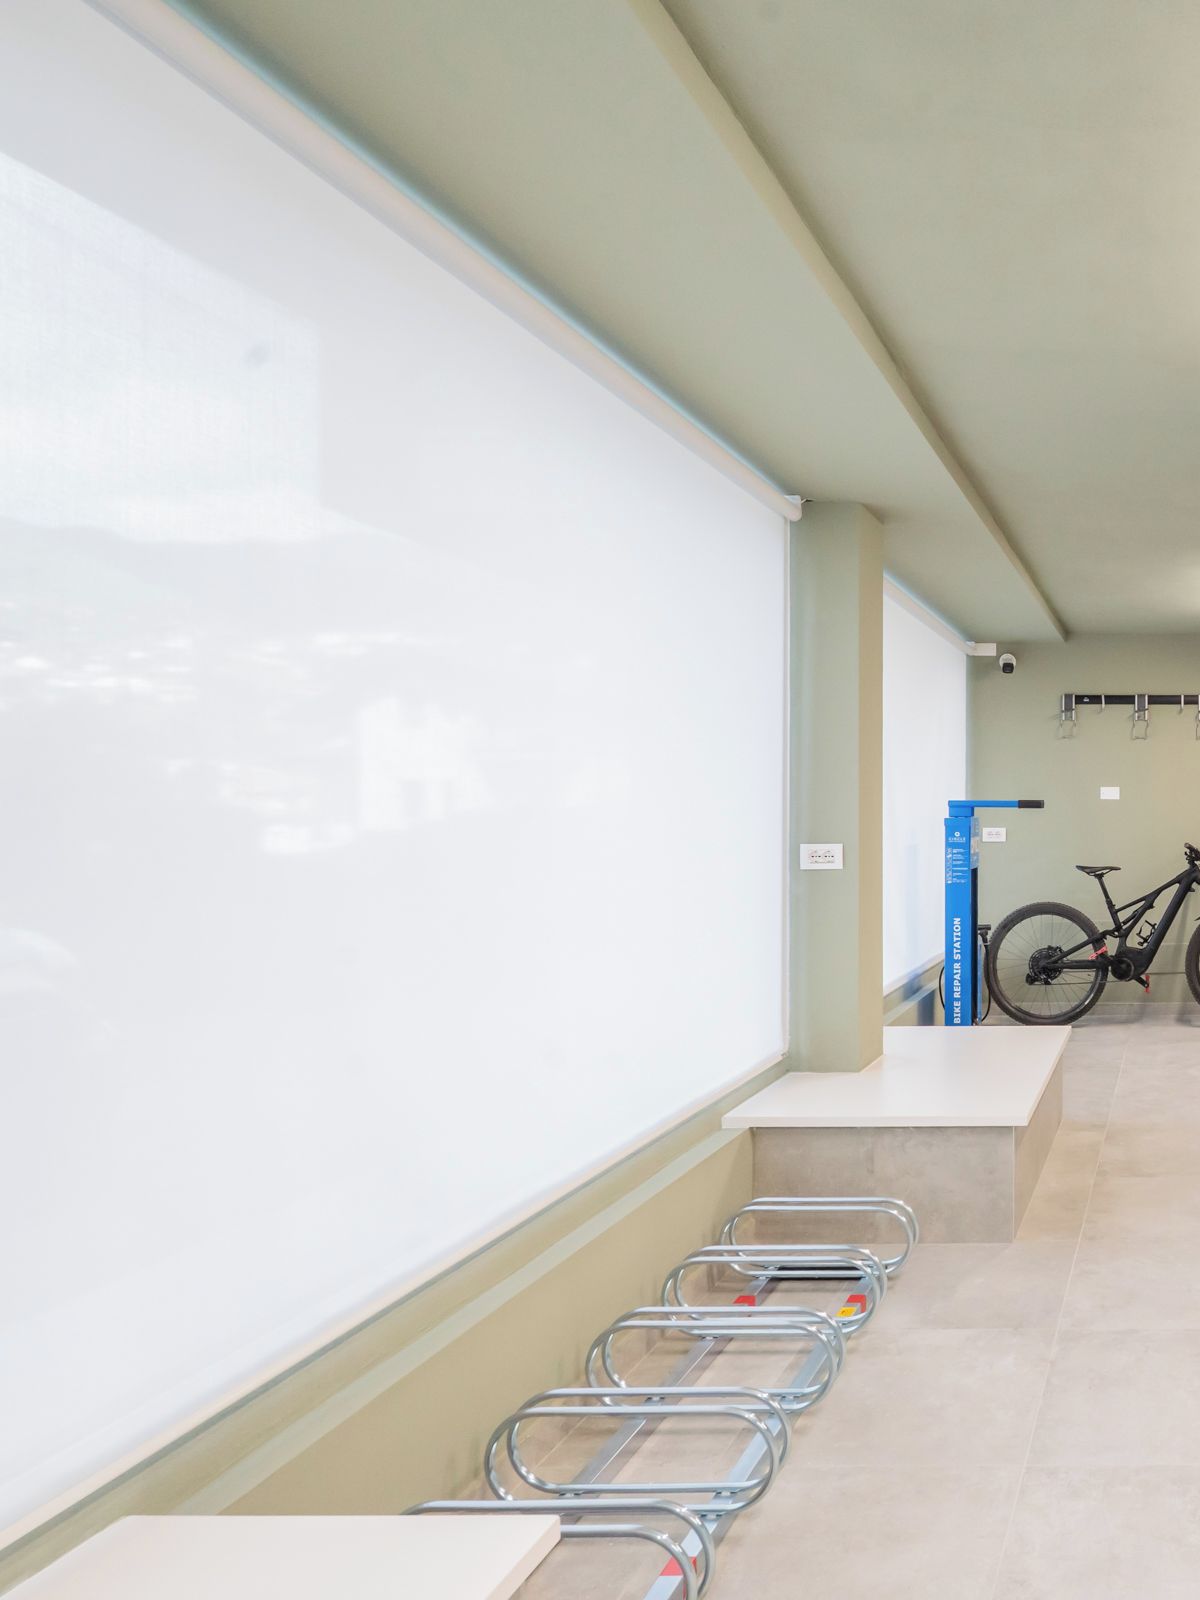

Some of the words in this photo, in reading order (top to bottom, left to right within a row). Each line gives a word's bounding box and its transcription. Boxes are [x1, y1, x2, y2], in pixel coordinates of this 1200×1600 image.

[953, 918, 961, 960] STATION
[953, 963, 961, 998] REPAIR
[953, 1001, 961, 1024] BIKE
